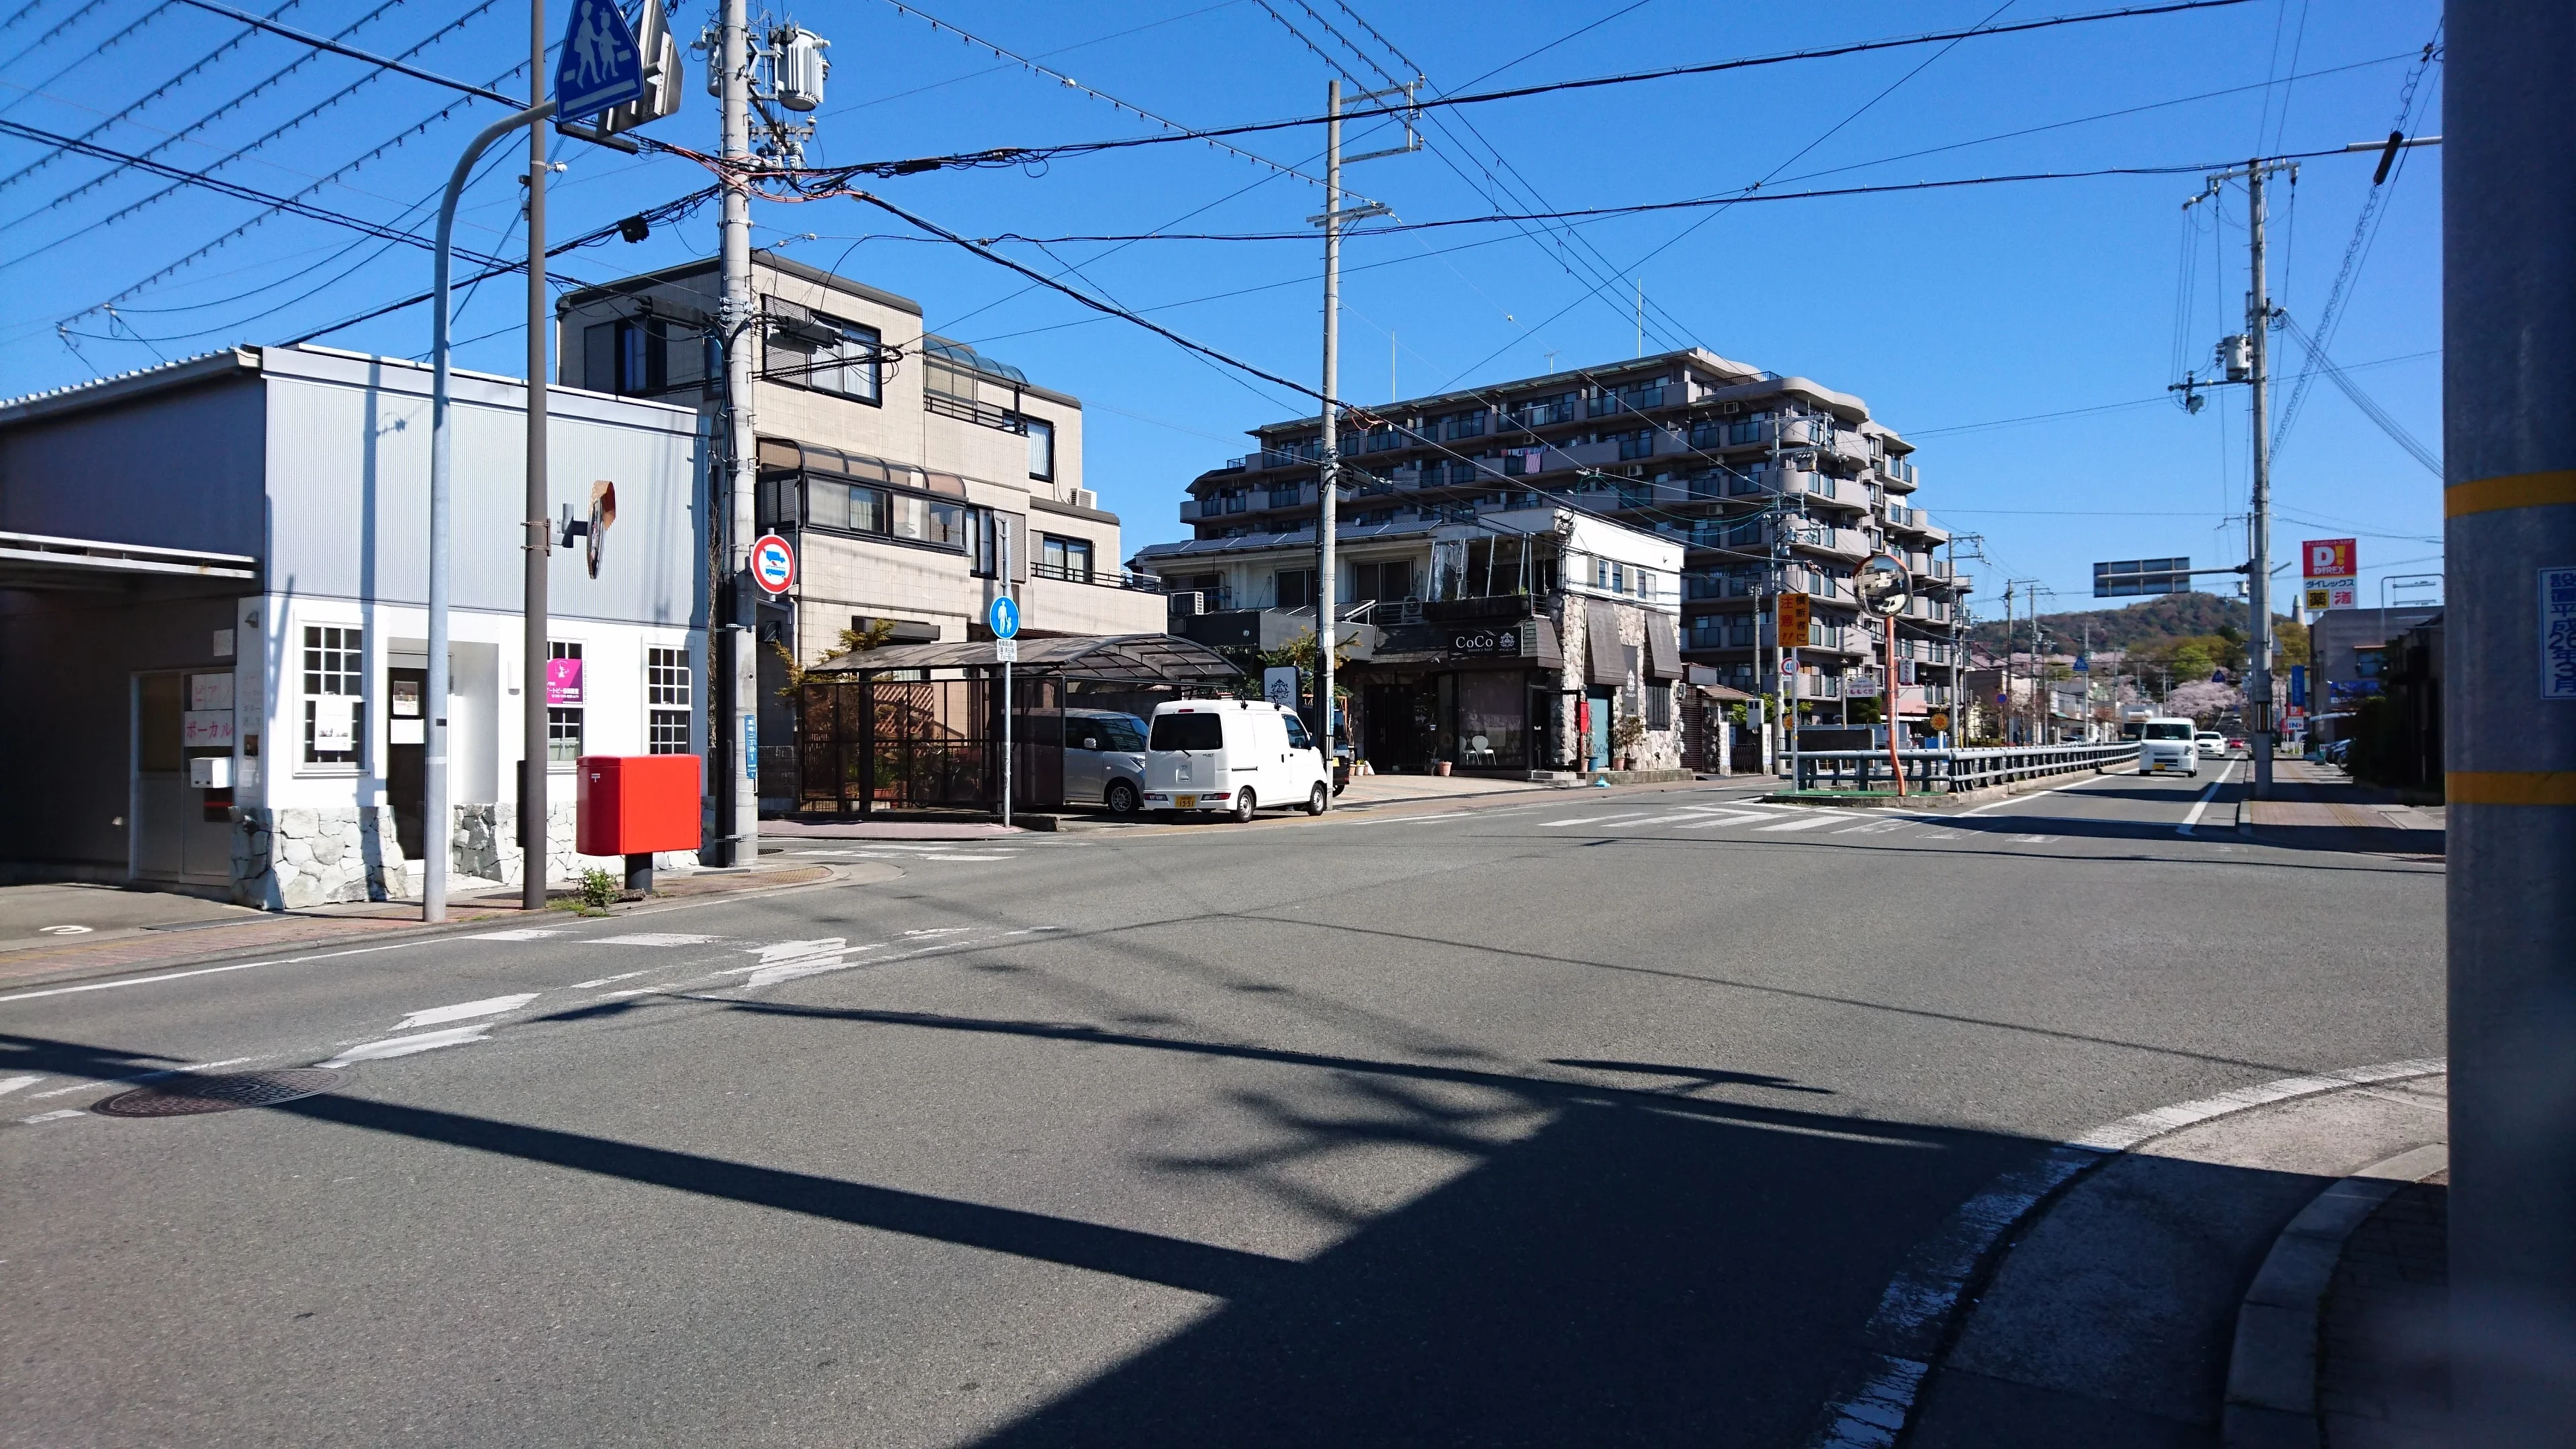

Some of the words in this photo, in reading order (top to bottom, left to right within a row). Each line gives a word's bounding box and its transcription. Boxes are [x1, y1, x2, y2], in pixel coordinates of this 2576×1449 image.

[2313, 566, 2345, 575] DIREX
[2306, 579, 2355, 588] ダイレックス
[1795, 595, 1806, 643] 横断者に
[1456, 635, 1493, 649] CoCo
[1593, 743, 1606, 754] CoCo
